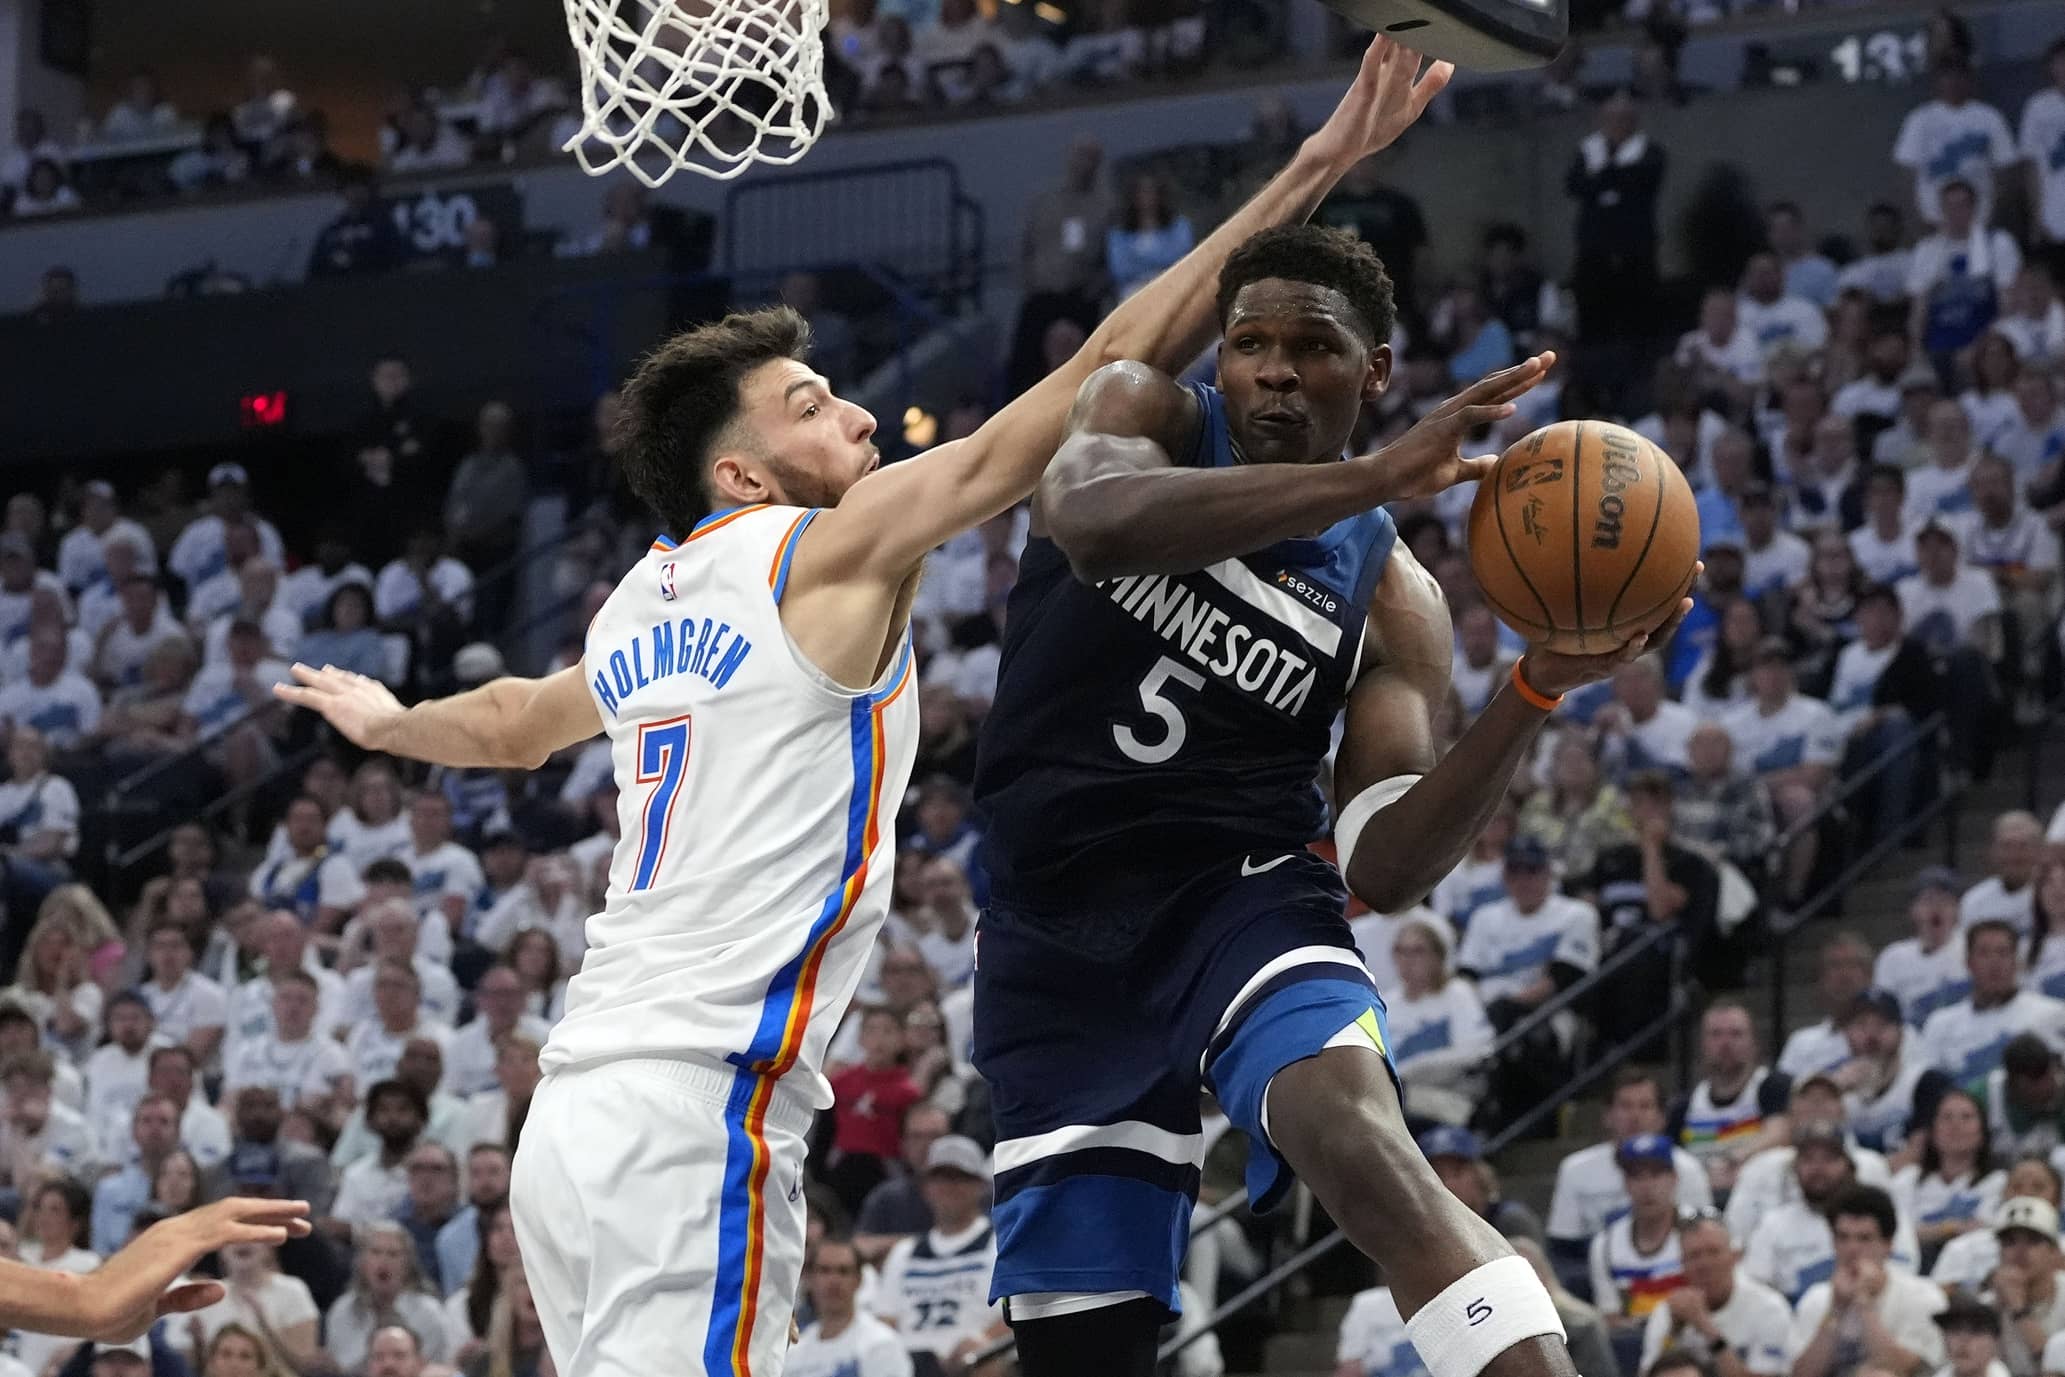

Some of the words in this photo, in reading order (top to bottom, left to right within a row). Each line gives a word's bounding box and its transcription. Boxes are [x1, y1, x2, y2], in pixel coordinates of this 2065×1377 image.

[1287, 576, 1337, 612] sezzle
[593, 618, 752, 719] HOLMGREN
[1112, 655, 1206, 764] 5
[627, 714, 692, 893] 7
[1466, 1297, 1493, 1327] 5
